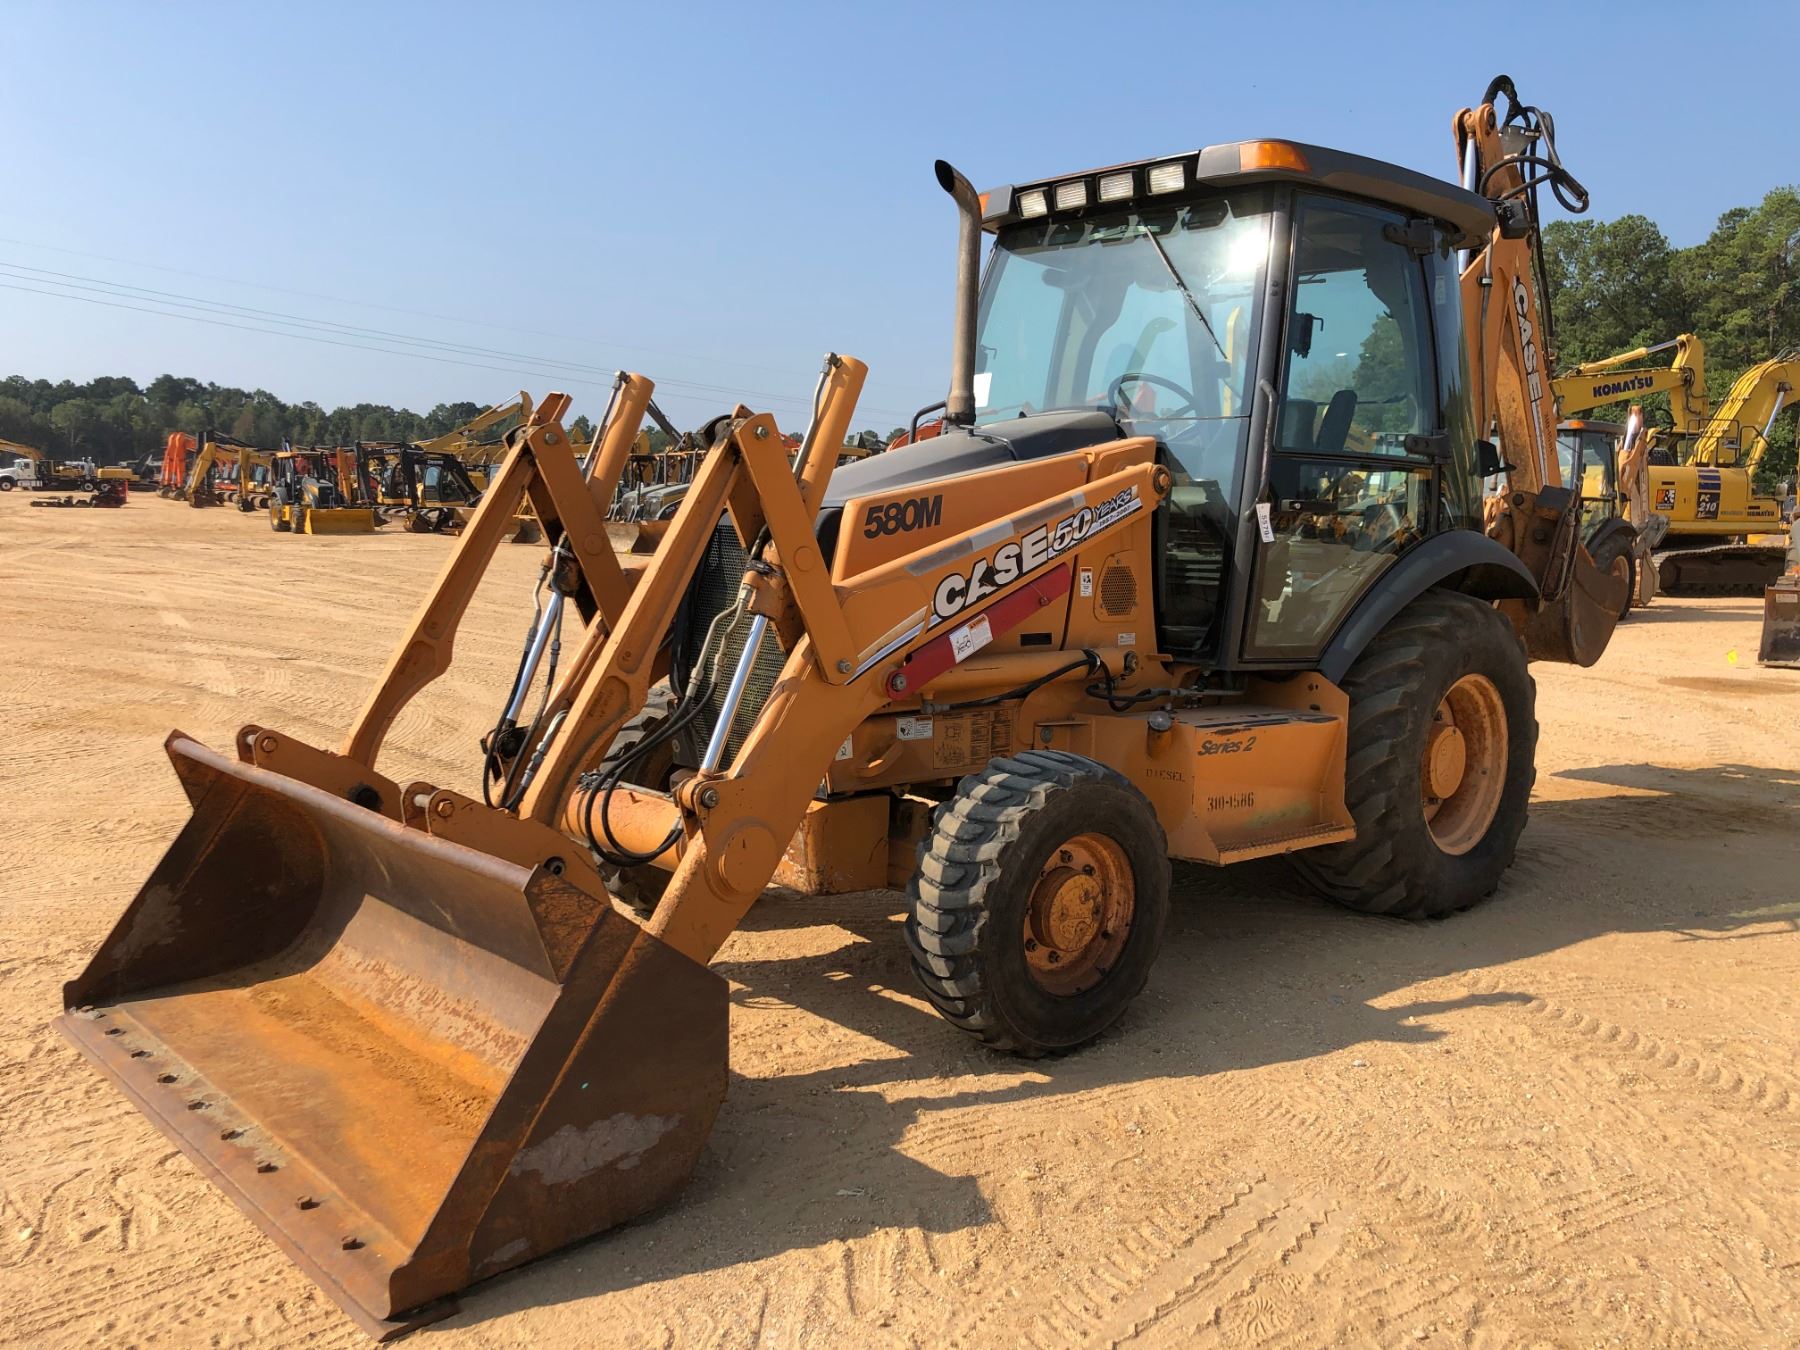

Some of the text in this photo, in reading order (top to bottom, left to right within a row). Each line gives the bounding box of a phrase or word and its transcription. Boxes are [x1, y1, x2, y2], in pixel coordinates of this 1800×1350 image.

[1514, 283, 1543, 401] CASE
[1592, 376, 1654, 398] KOMATSU
[1698, 502, 1717, 512] 210
[1699, 494, 1711, 502] PC
[863, 494, 943, 540] 580M
[933, 524, 1049, 621] CASE
[1051, 506, 1095, 553] 50
[1093, 487, 1133, 522] YEARS
[1197, 736, 1257, 756] Series 2
[1145, 768, 1186, 783] DIESEL
